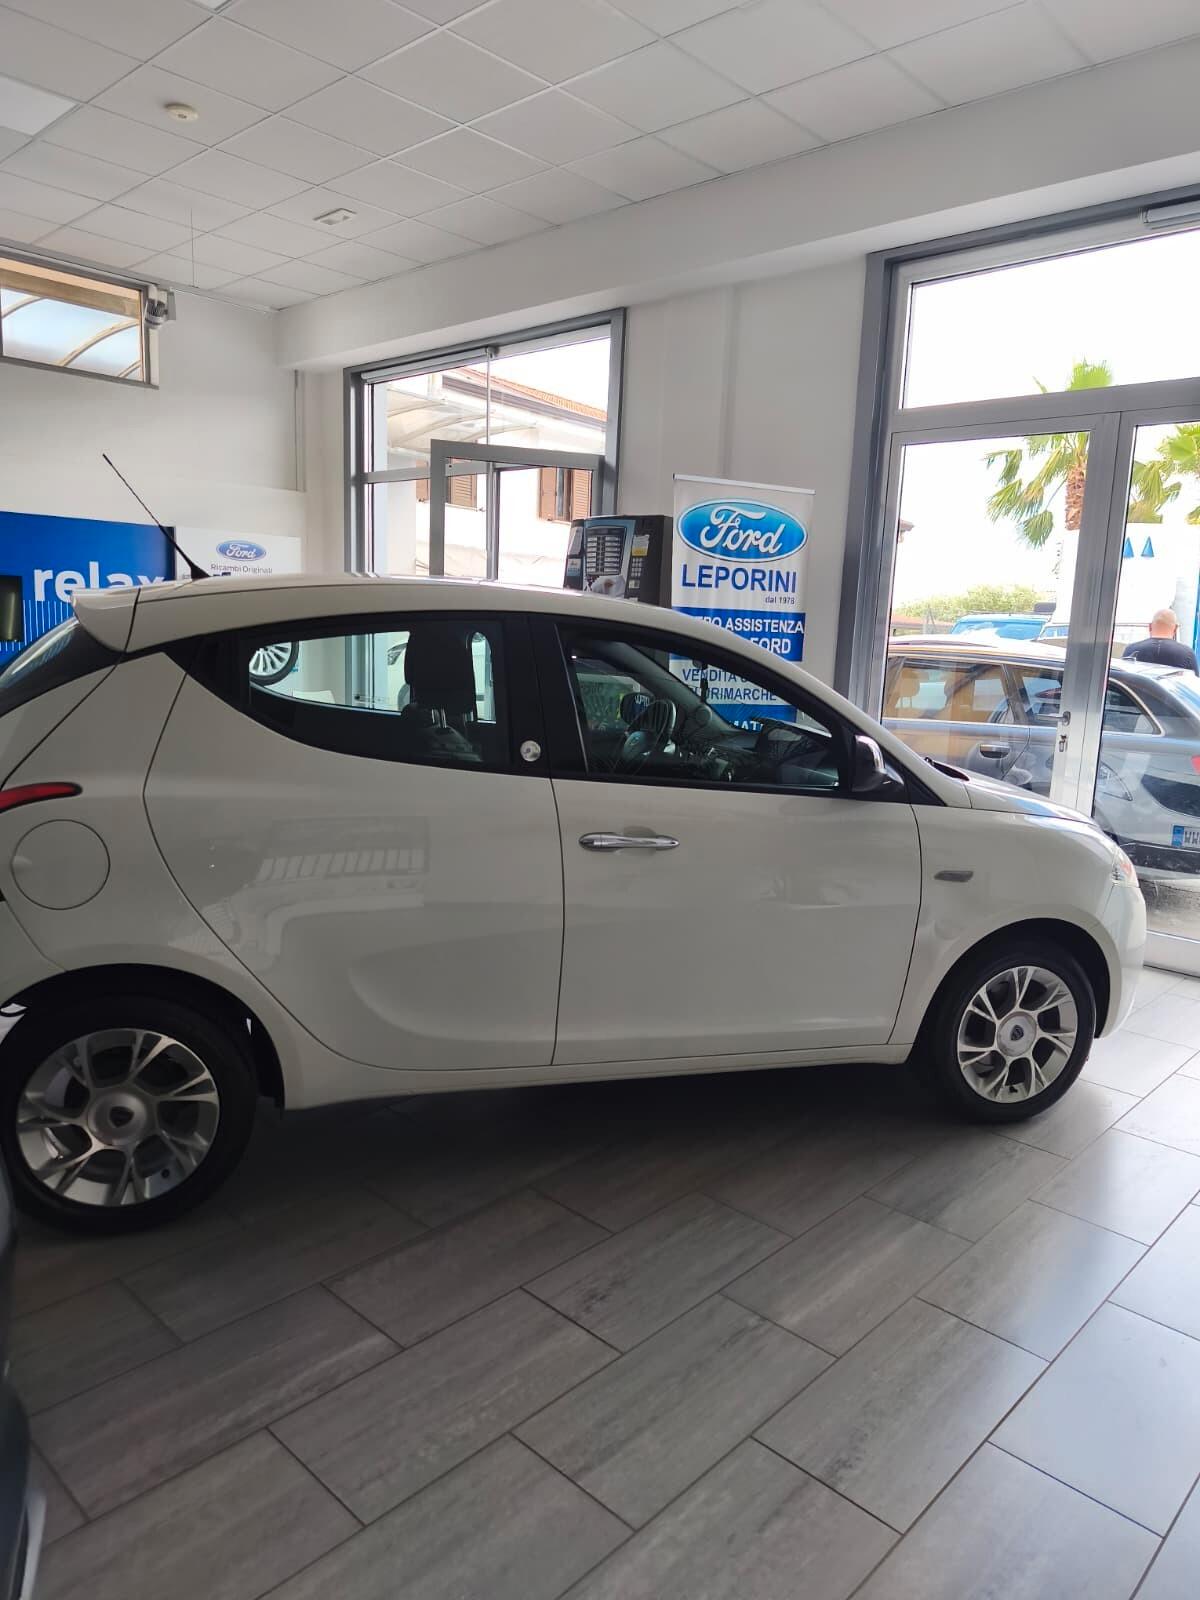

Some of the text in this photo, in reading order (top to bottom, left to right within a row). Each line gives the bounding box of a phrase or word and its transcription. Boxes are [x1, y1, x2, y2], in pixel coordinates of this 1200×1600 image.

[700, 505, 786, 554] Ford
[226, 543, 257, 559] Ford
[210, 563, 242, 574] Ricambi
[681, 563, 797, 594] LEPORINI
[765, 596, 777, 605] dal
[725, 617, 805, 634] ASSISTENZA
[682, 668, 737, 683] VENDITA
[691, 687, 777, 701] RIMARCHE
